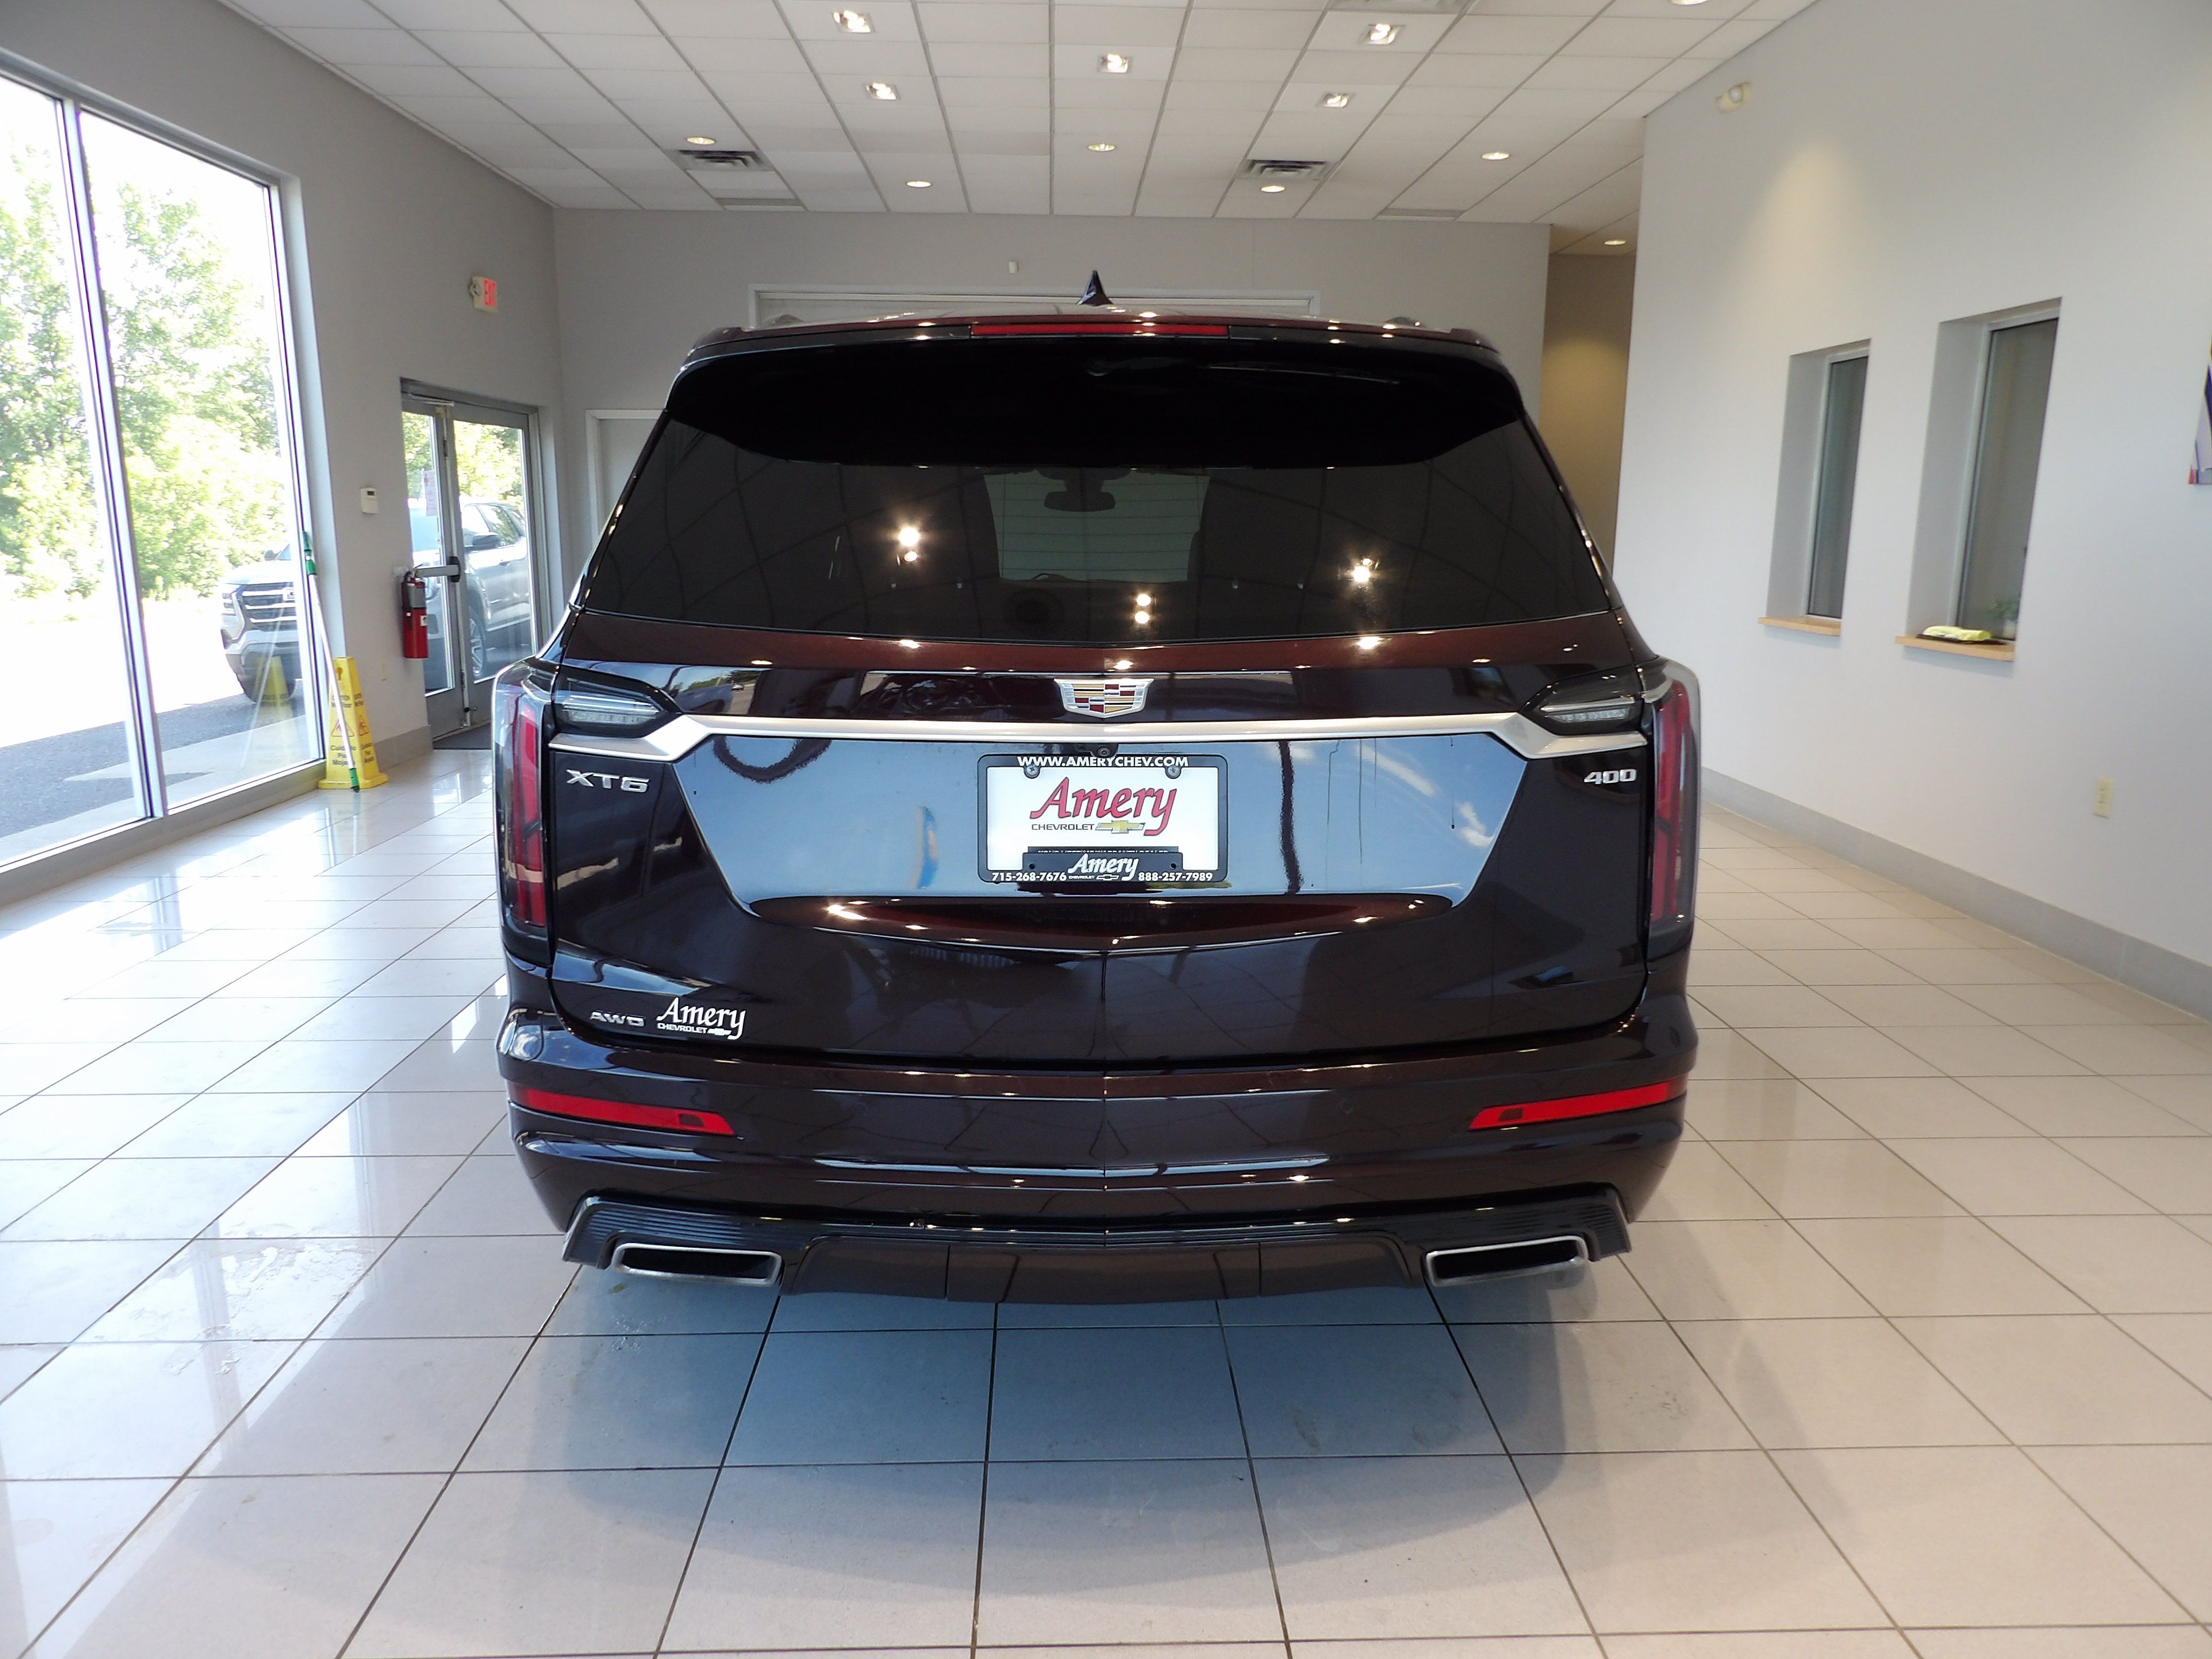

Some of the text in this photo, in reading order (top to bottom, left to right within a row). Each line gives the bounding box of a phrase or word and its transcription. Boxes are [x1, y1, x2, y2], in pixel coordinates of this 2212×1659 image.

[1017, 756, 1189, 767] WWW.AMERYCHEV.COM
[566, 769, 650, 793] XT6
[1584, 769, 1636, 784] 400
[1030, 776, 1178, 836] Amery
[1068, 853, 1139, 881] Amery
[992, 872, 1067, 881] 715-268-7676
[1138, 872, 1213, 881] 888-257-7989
[589, 1011, 645, 1027] AWD
[656, 997, 746, 1040] Amery
[657, 1022, 709, 1034] CHEVROLET
